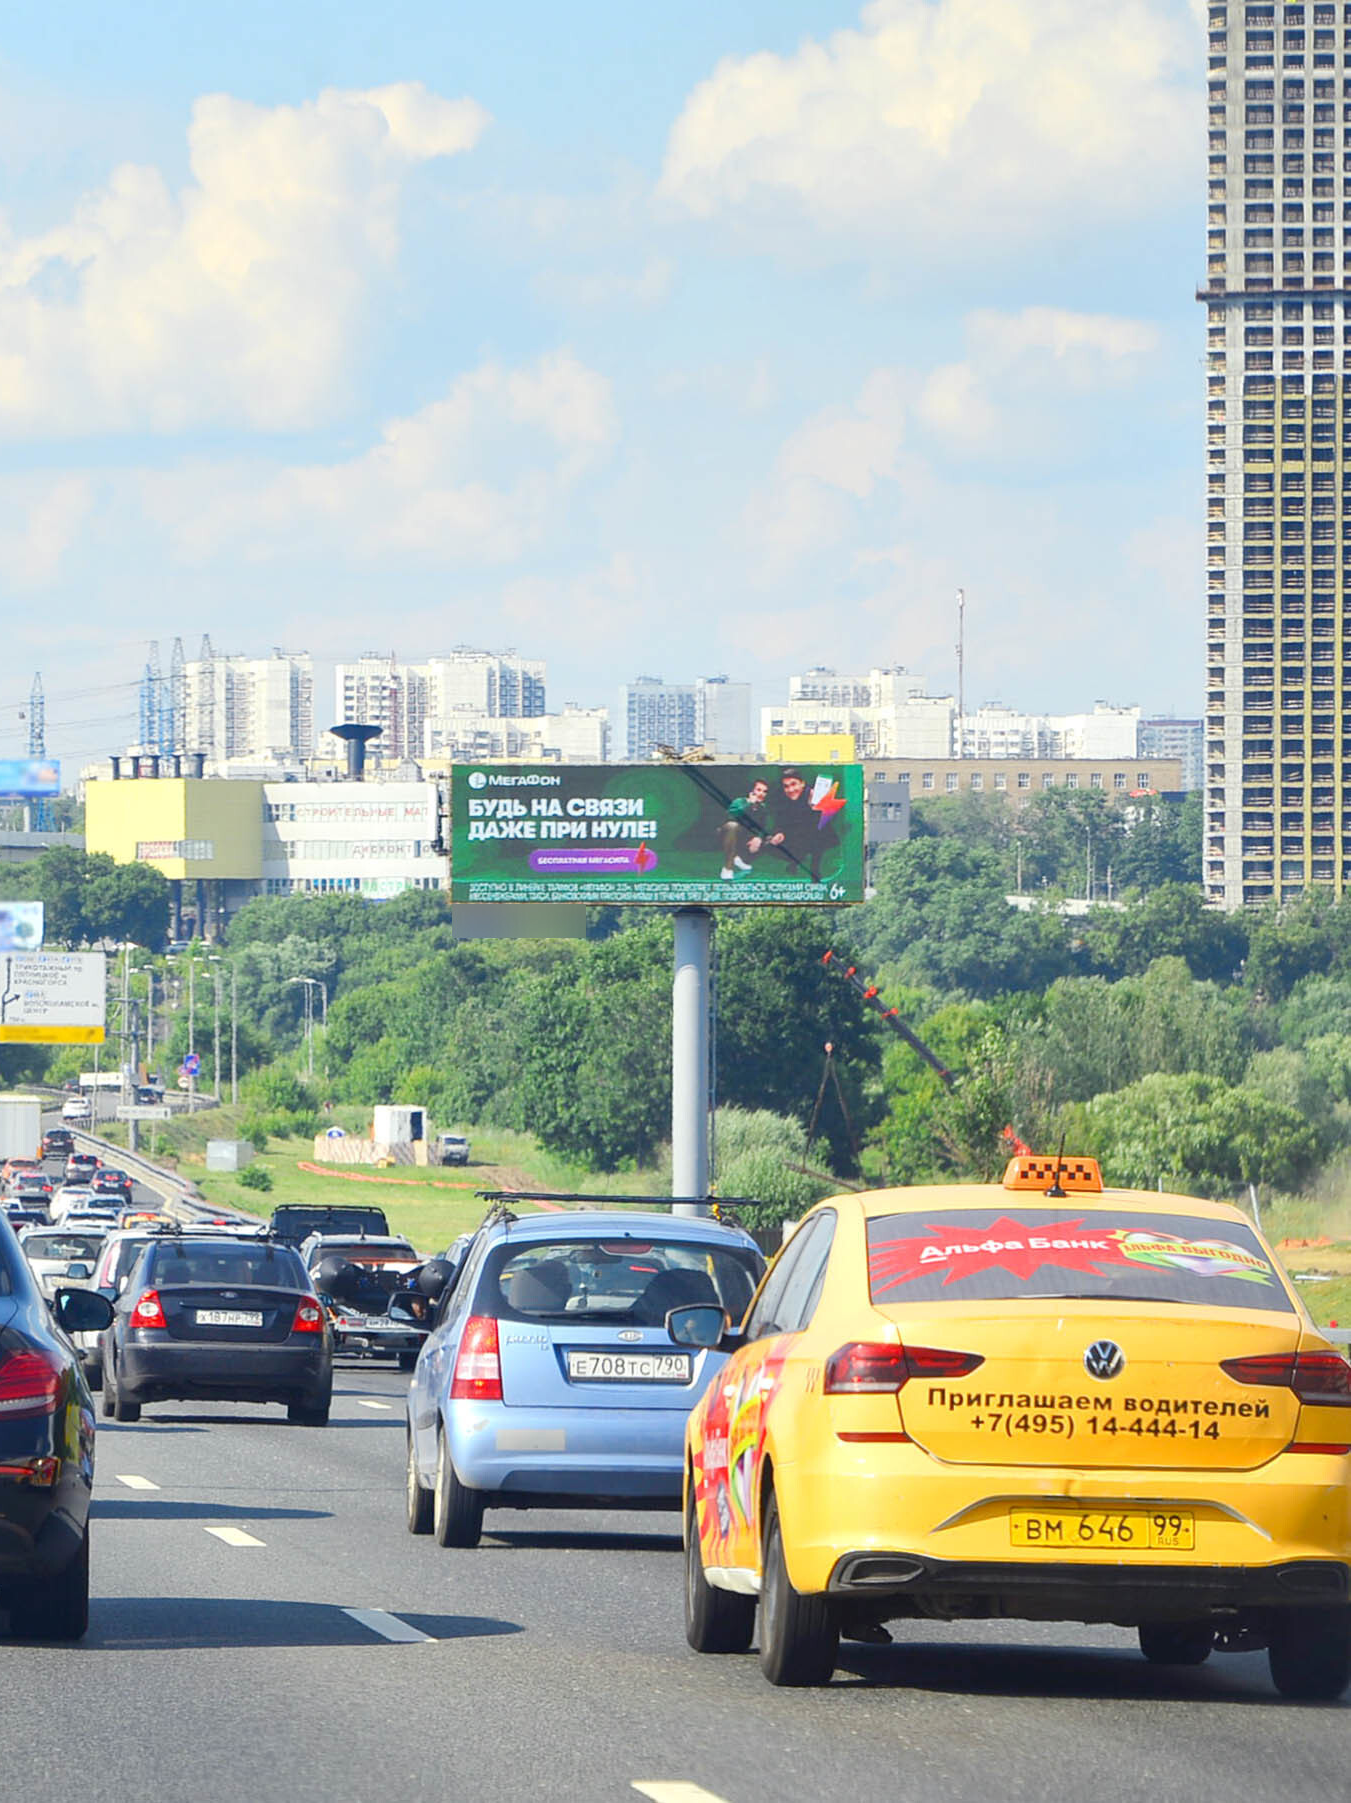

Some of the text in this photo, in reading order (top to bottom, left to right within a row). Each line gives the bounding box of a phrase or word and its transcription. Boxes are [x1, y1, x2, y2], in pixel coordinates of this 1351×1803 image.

[297, 807, 394, 816] СТРОИТЕЛЬНЫЕ
[468, 799, 644, 818] БУДЬ НА СВЯЗИ
[468, 821, 658, 840] ДАЖЕ ПРИ НУЛЕ!
[538, 857, 587, 865] БЕСПЛАТНАЯ
[829, 884, 846, 900] 6+
[920, 1238, 1109, 1262] Альфа Банк
[1124, 1243, 1267, 1270] АЛЬФА ВЫГОДНО
[576, 1356, 683, 1375] Е708ТС 790
[928, 1387, 1269, 1418] Приглашаем водителей
[971, 1413, 1220, 1440] +7(495) 14-444-14
[1027, 1515, 1182, 1542] ВМ 646 99
[1158, 1537, 1179, 1546] RUS
